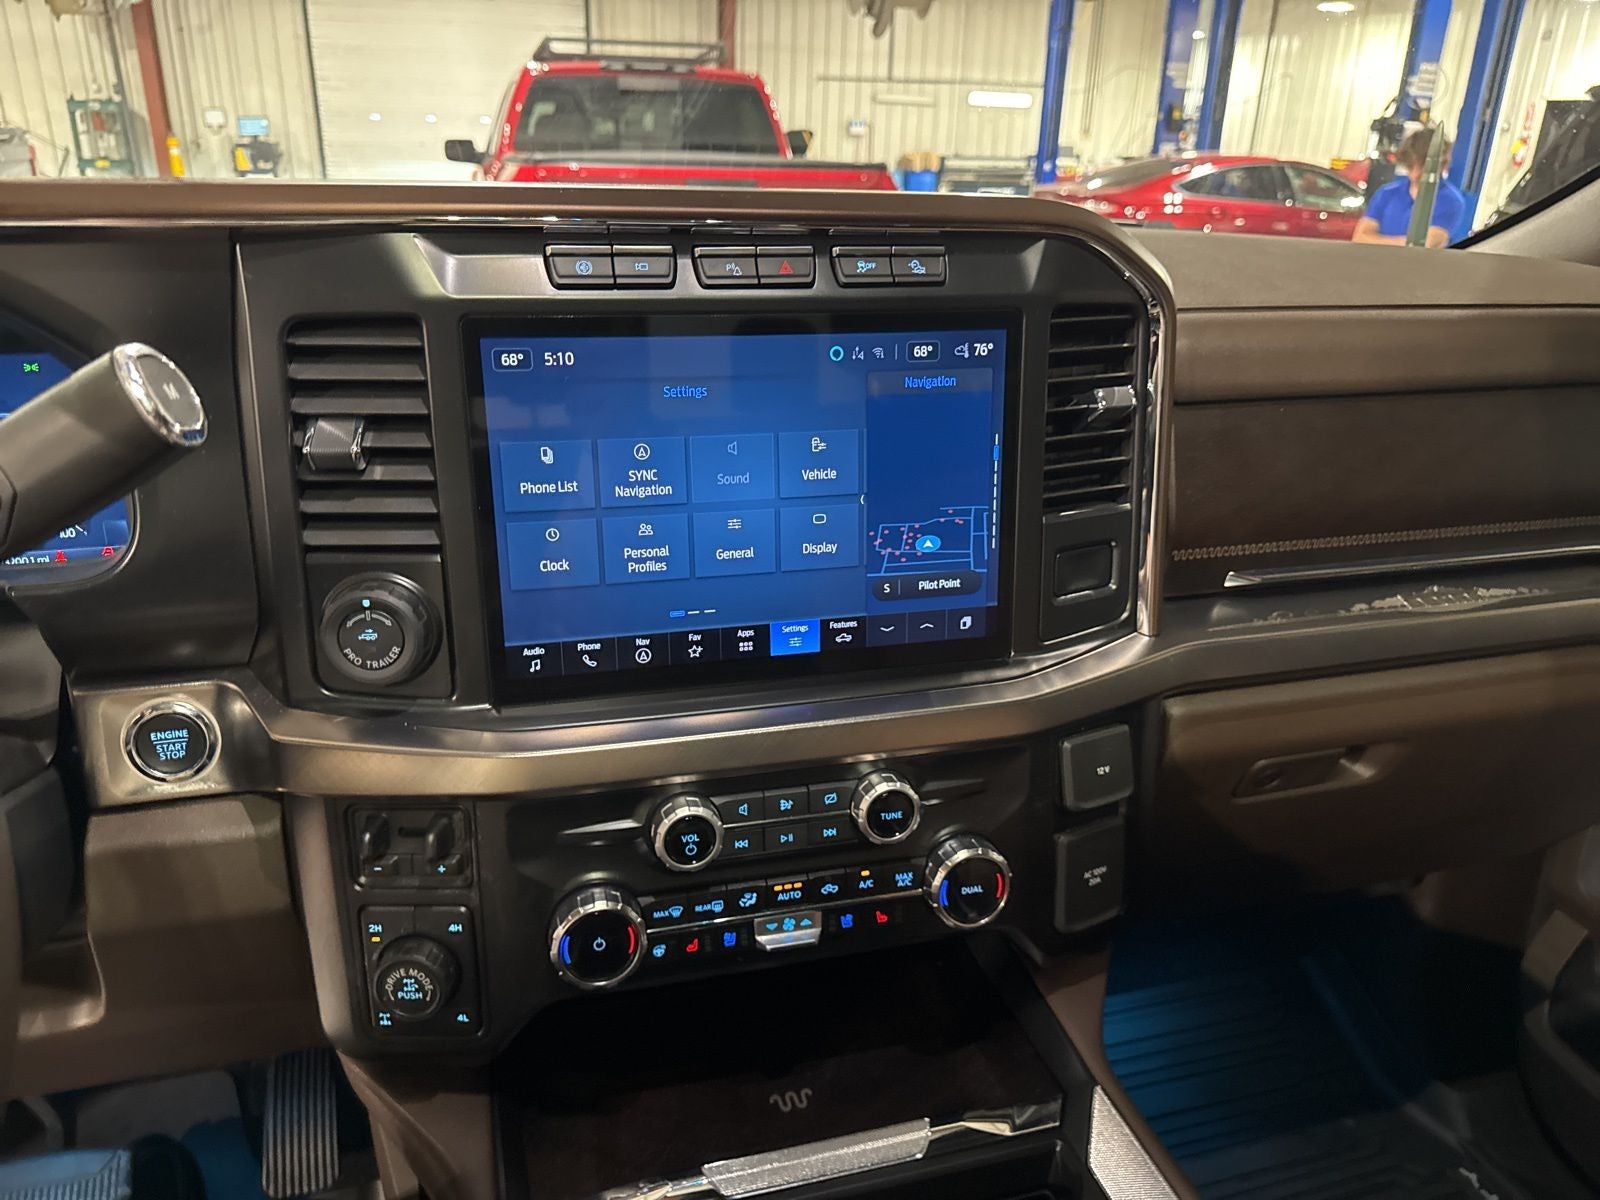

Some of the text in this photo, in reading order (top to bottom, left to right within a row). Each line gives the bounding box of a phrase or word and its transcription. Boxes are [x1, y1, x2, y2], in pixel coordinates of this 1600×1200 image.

[865, 262, 876, 270] OFF
[913, 345, 933, 358] 68°
[973, 342, 994, 357] 76°
[501, 353, 524, 366] 68°
[544, 351, 574, 366] 5:10
[905, 375, 957, 389] Navigation
[663, 385, 708, 399] Settings
[628, 469, 658, 482] SYNC
[717, 472, 750, 485] Sound
[801, 468, 837, 481] Vehicle
[519, 480, 578, 495] Phone List
[615, 483, 673, 498] Navigation
[623, 545, 670, 559] Personal
[715, 546, 755, 560] General
[802, 542, 838, 555] Display
[539, 558, 570, 572] Clock
[628, 561, 667, 573] Profiles
[883, 583, 891, 593] S
[918, 578, 961, 591] Pilot Point
[781, 624, 809, 634] Settings
[829, 619, 858, 630] Features
[688, 633, 702, 642] Fav
[737, 628, 755, 638] Apps
[577, 642, 601, 652] Phone
[635, 637, 651, 646] Nav
[522, 646, 545, 656] Audio
[343, 645, 402, 670] PRO TRAILER
[150, 729, 189, 741] ENGINE
[156, 742, 187, 753] START
[160, 750, 186, 761] STOP
[880, 811, 903, 821] TUNE
[681, 834, 700, 843] VOL
[895, 871, 914, 881] MAX
[858, 879, 874, 889] A/C
[897, 879, 913, 888] A/C
[777, 890, 802, 901] AUTO
[961, 886, 983, 895] DUAL
[653, 910, 670, 918] MAX
[694, 904, 711, 913] REAR
[368, 924, 382, 933] 2H
[448, 924, 462, 932] 4H
[385, 968, 434, 991] DRIVE MODE
[397, 991, 423, 1000] PUSH
[457, 1014, 469, 1022] 4L
